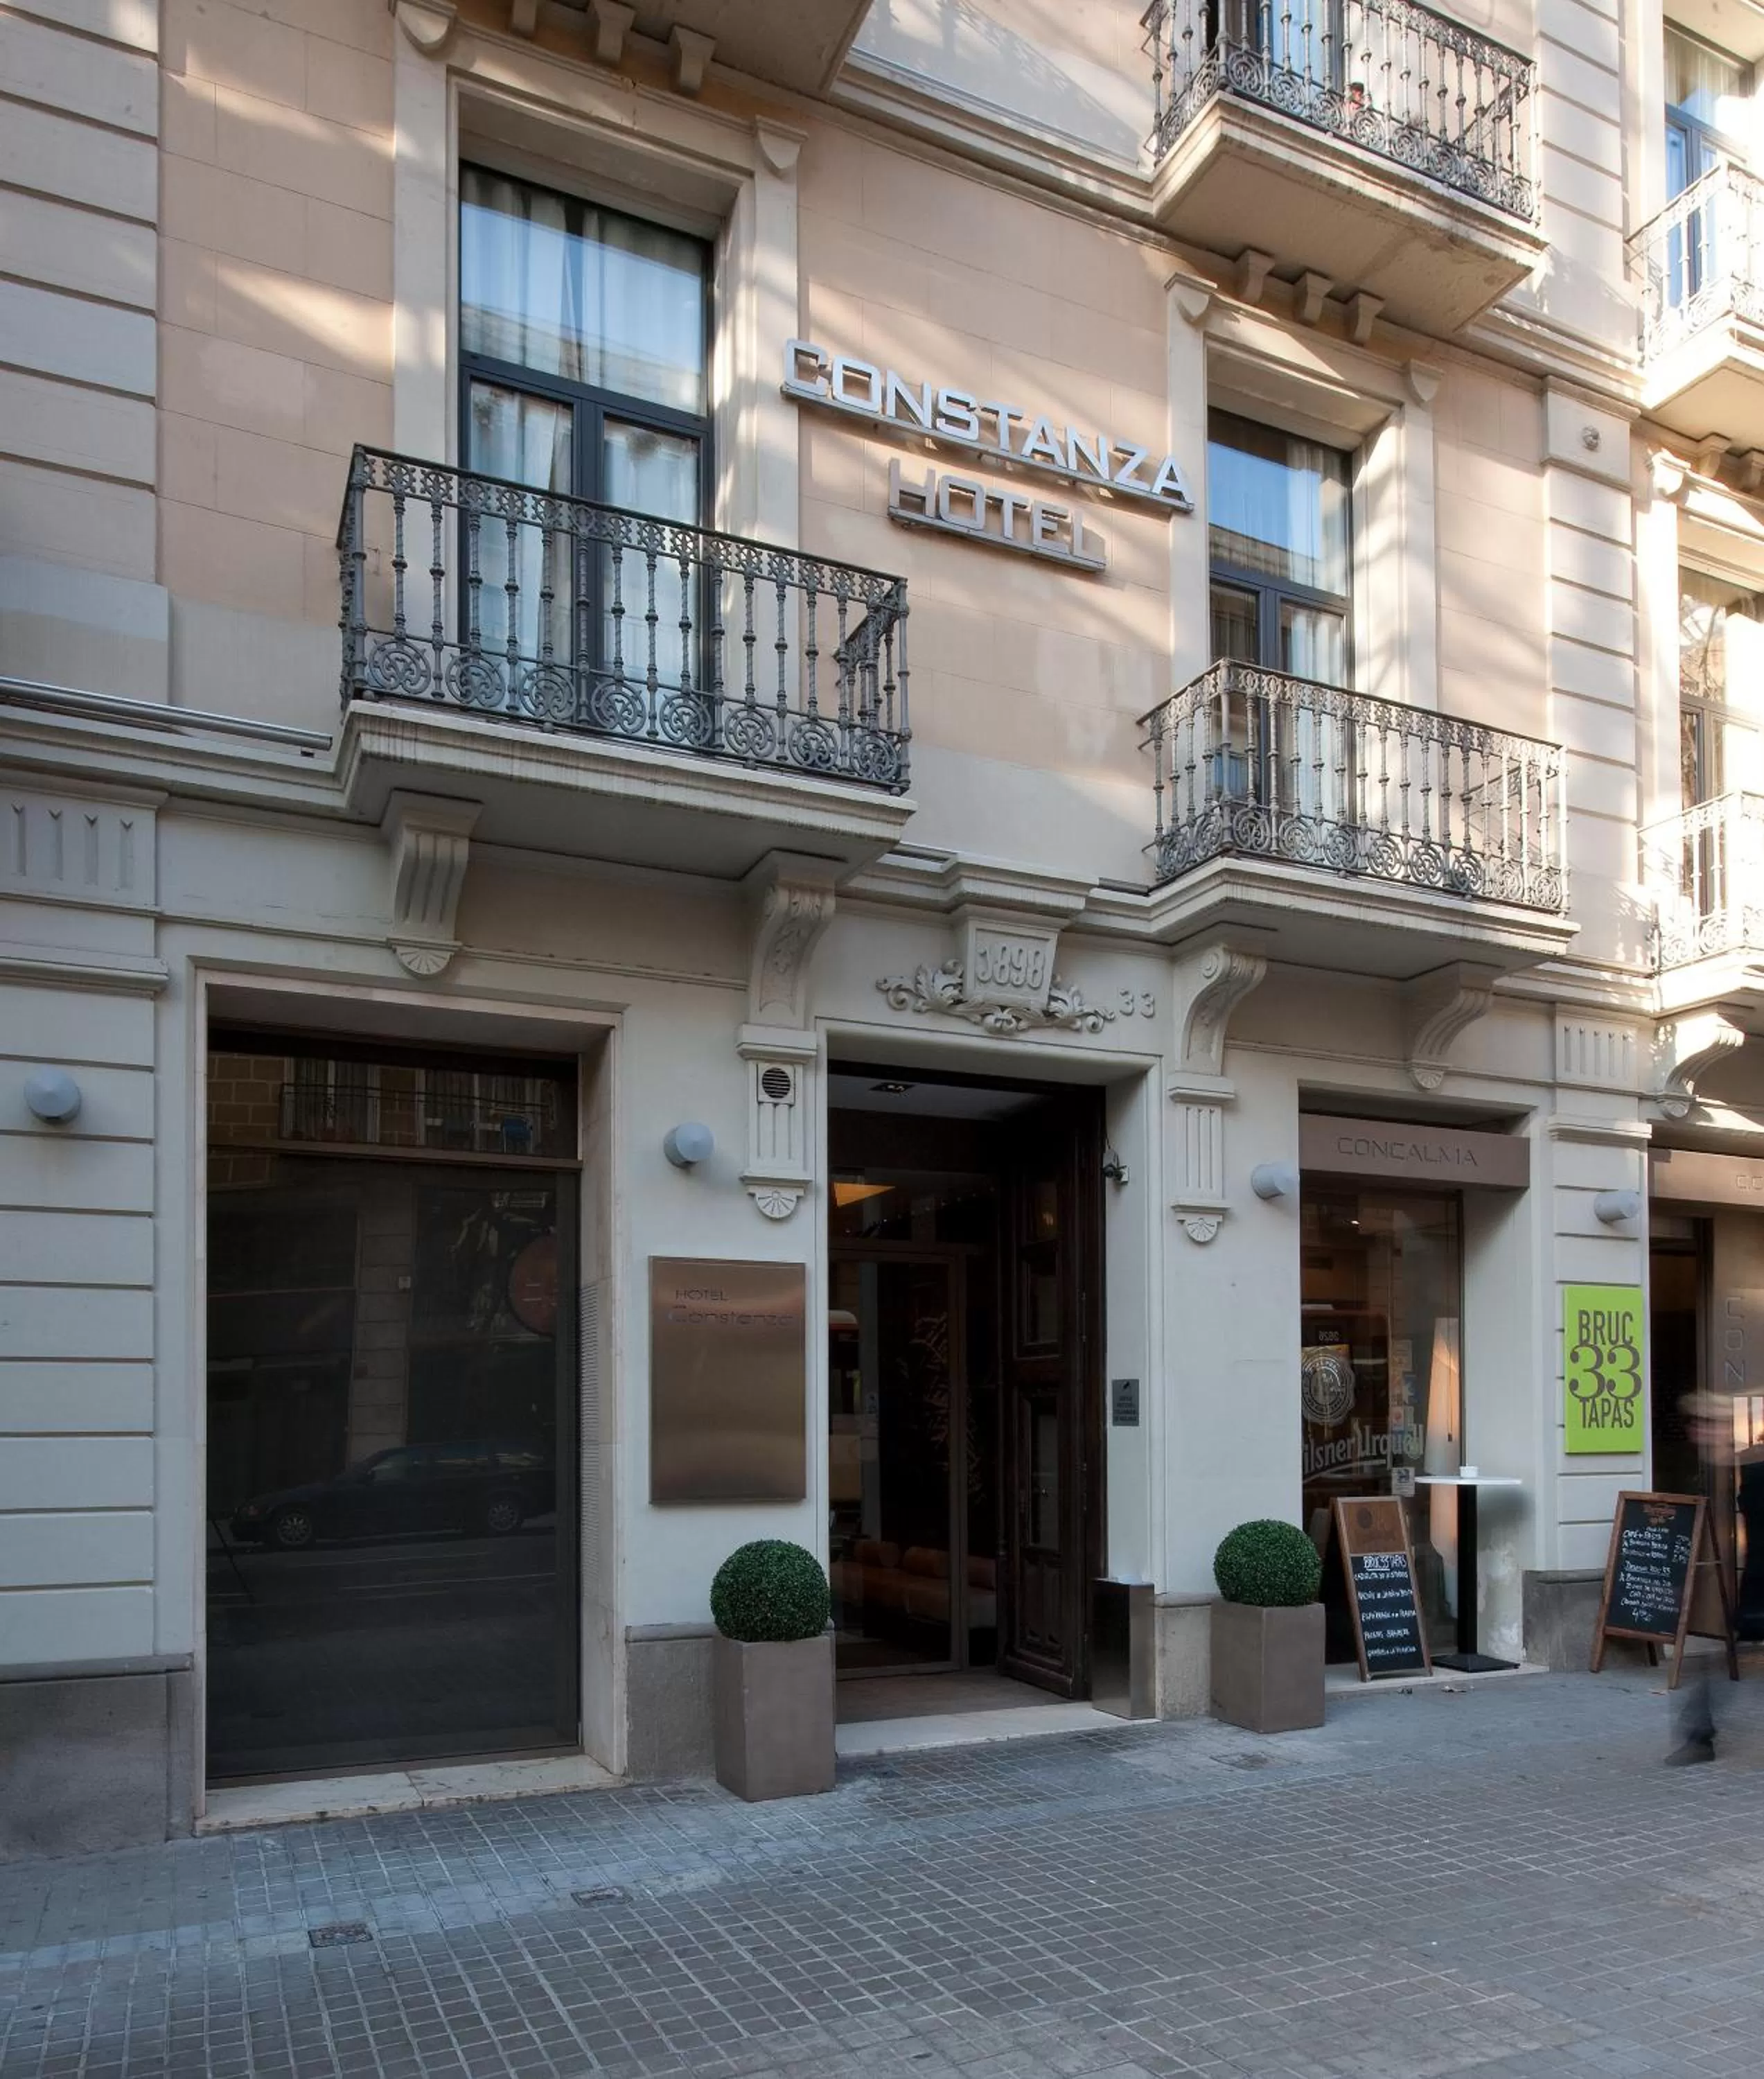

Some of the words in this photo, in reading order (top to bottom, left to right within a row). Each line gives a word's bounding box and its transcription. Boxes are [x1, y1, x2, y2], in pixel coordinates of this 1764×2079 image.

[784, 338, 1193, 505] CONSTANZA
[889, 457, 1106, 563] HOTEL
[1119, 989, 1156, 1018] 33
[676, 1289, 730, 1301] HOTEL
[1578, 1309, 1634, 1345] BRUC
[1569, 1344, 1642, 1400] 33
[1579, 1398, 1634, 1428] TAPAS
[1302, 1436, 1356, 1475] ilsner
